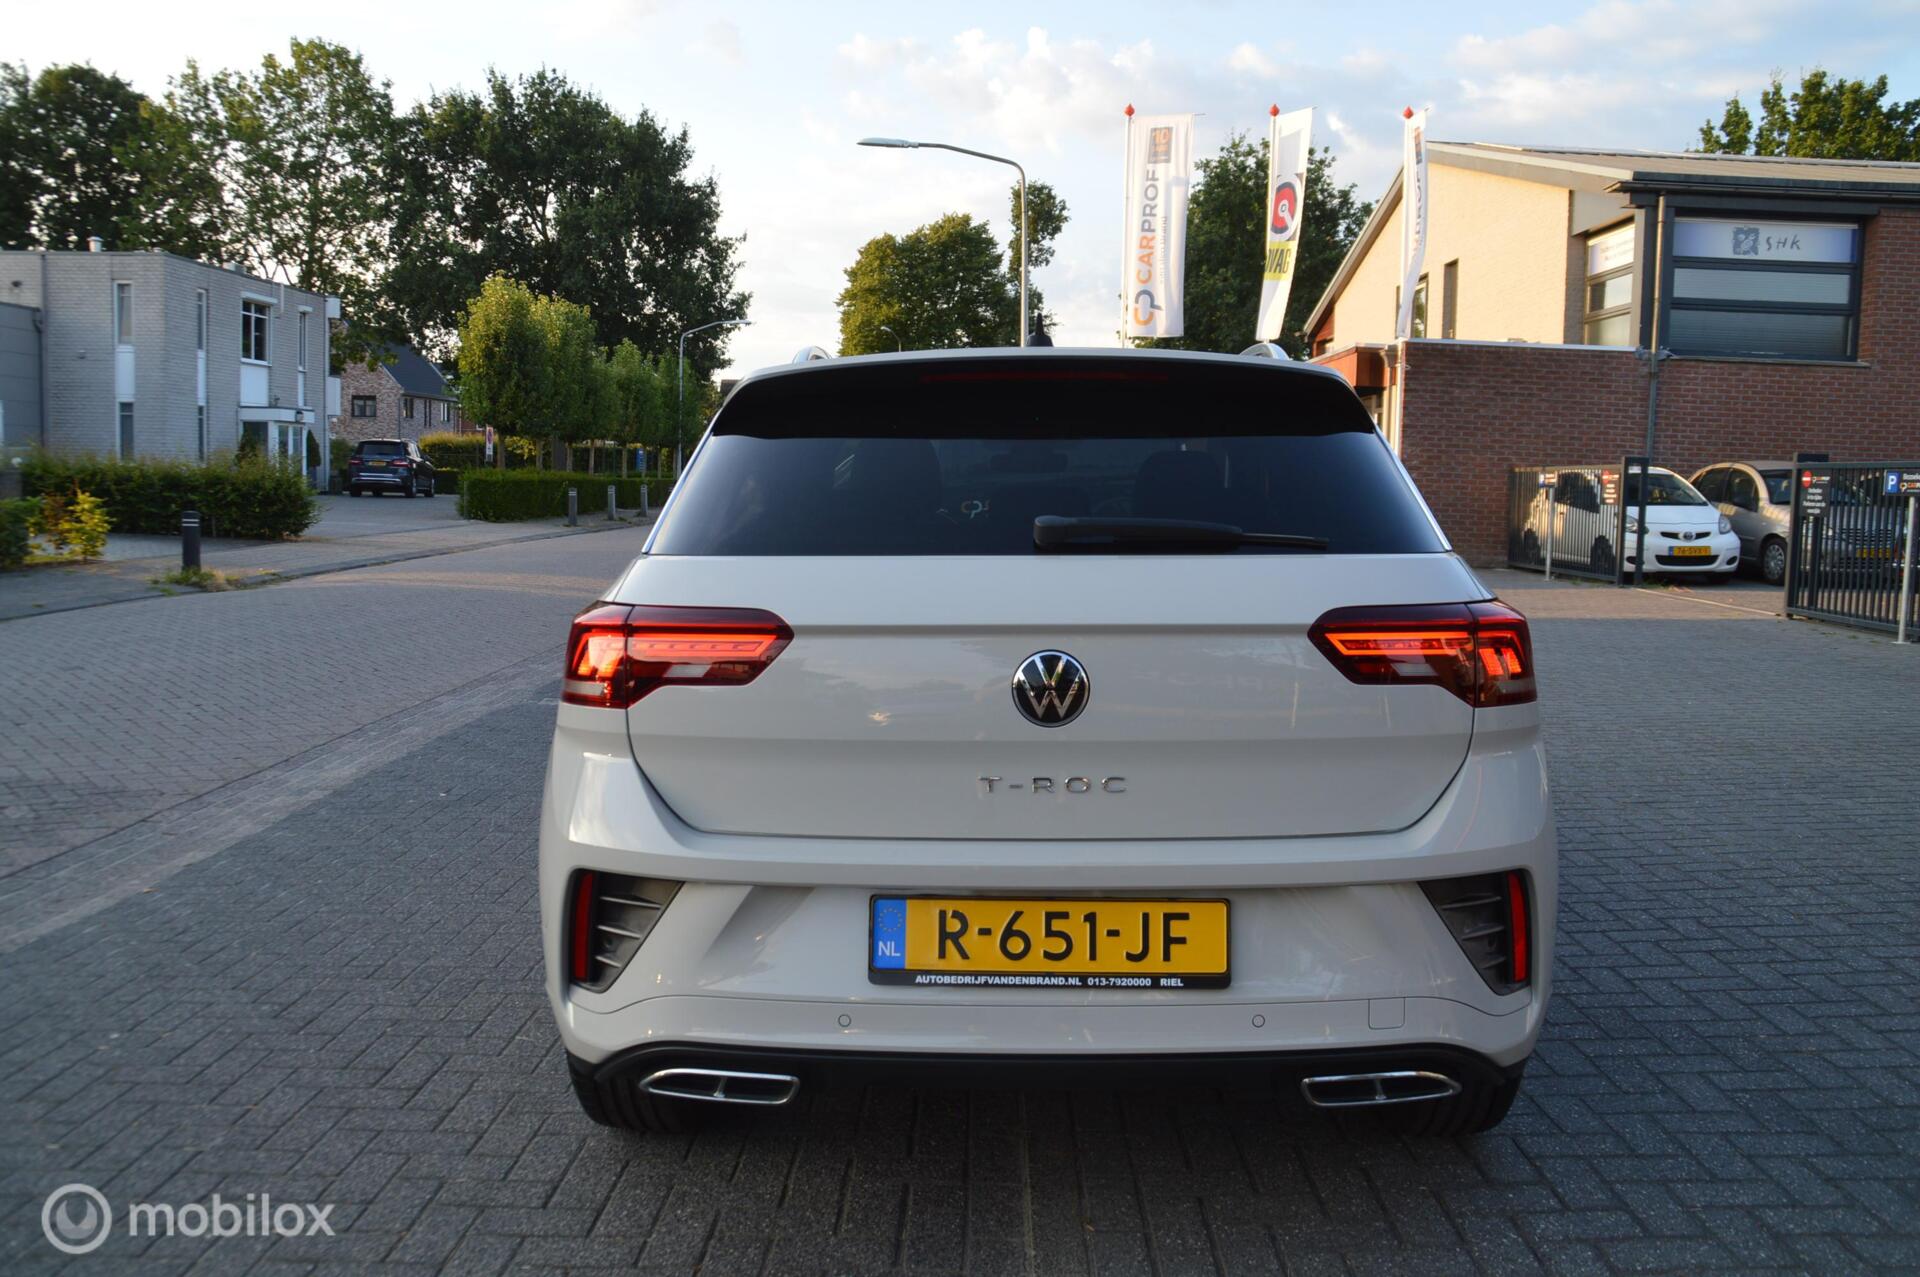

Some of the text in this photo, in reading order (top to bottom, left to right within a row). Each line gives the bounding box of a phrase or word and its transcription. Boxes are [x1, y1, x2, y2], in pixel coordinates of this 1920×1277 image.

[1136, 169, 1159, 284] CARPROF
[978, 775, 1128, 794] T-ROC
[937, 908, 1190, 962] R-651-JF
[878, 940, 901, 957] NL
[915, 974, 1184, 987] AUTOBEDRIJFVANDENBRAND.NL 013-7920000 RIEL
